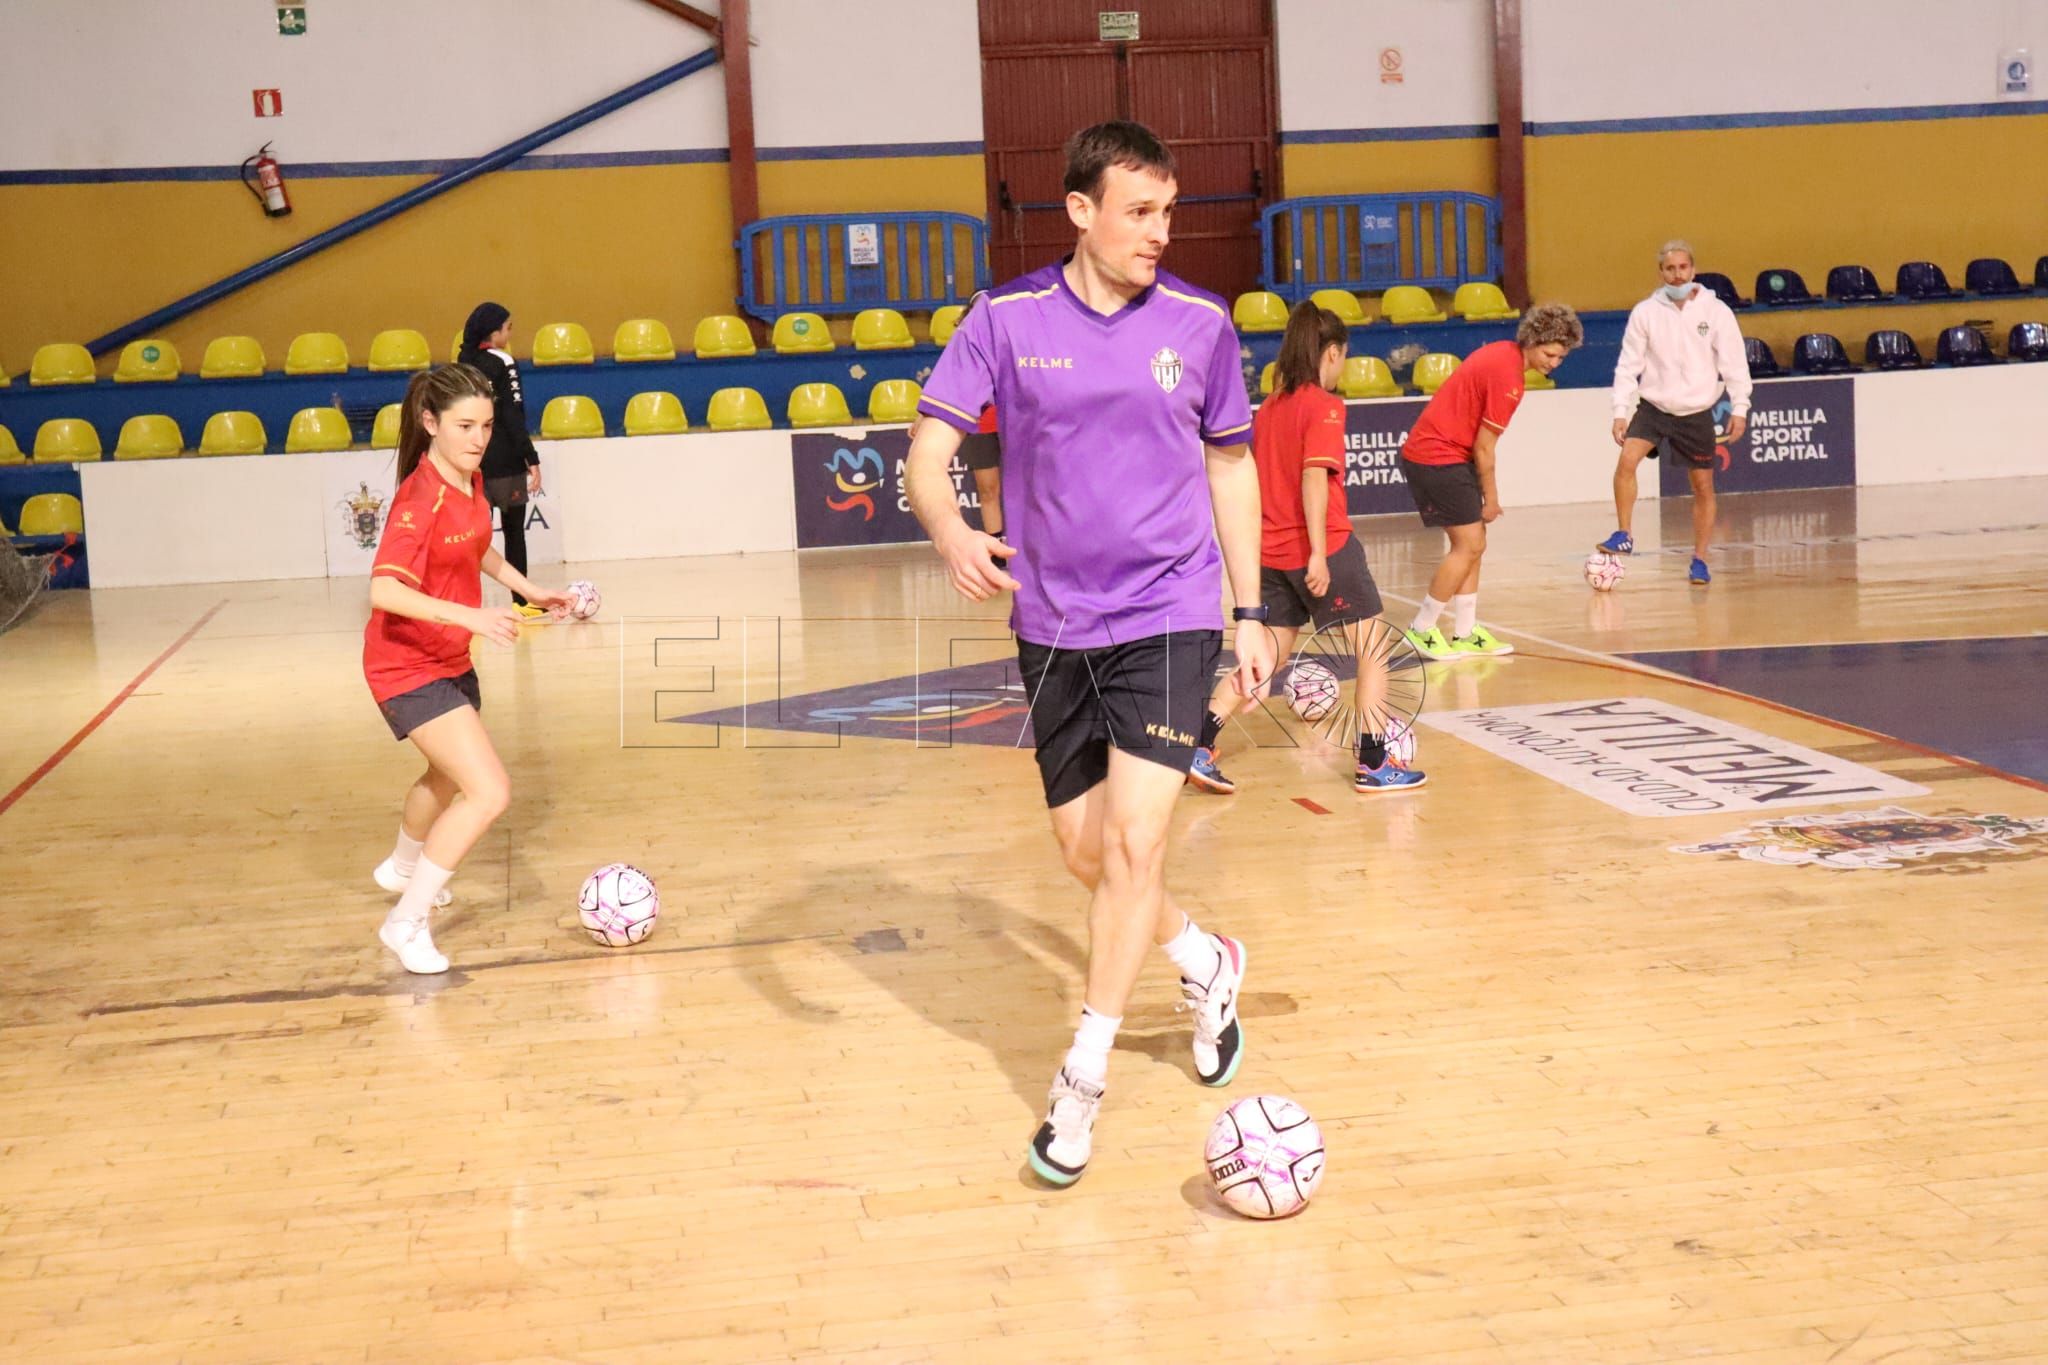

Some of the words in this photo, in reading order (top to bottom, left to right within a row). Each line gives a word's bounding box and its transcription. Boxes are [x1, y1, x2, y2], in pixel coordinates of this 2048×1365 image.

[1018, 357, 1073, 368] KELME
[1751, 408, 1827, 427] MELILLA
[1751, 426, 1813, 445] SPORT
[1345, 450, 1397, 468] PORT
[1751, 444, 1828, 463] CAPITAL
[1343, 468, 1407, 486] APITA
[1146, 723, 1195, 747] KELME
[1456, 711, 1622, 765] AUTÓNOMA
[1536, 701, 1884, 803] MELILLA
[1592, 768, 1725, 811] CIUDAD
